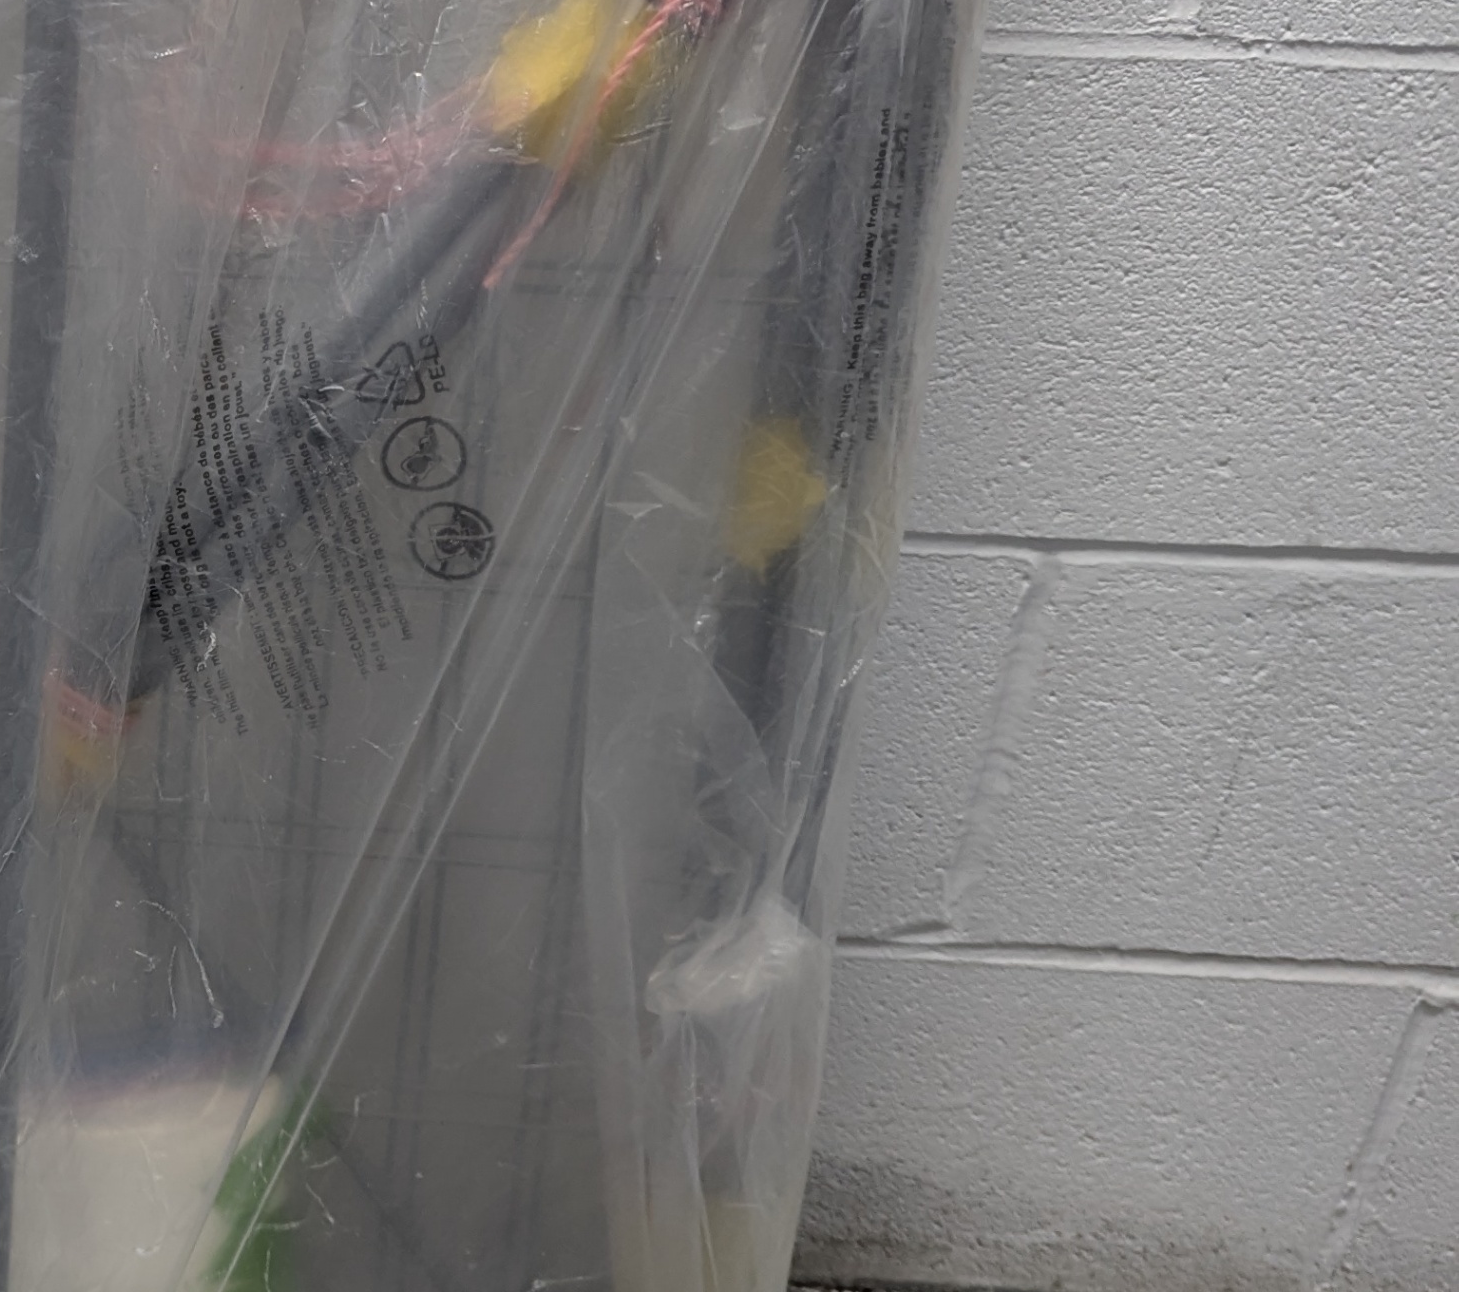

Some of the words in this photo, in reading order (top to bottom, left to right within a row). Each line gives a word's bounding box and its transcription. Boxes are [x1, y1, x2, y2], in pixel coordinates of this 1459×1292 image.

[879, 108, 891, 136] and
[871, 140, 888, 189] babies
[865, 193, 880, 228] from
[862, 232, 877, 268] away
[855, 273, 872, 299] bag
[852, 304, 866, 330] this
[208, 324, 227, 371] collant
[847, 334, 862, 370] Keep
[200, 353, 215, 391] parcs
[419, 335, 449, 393] PE-LD
[218, 374, 229, 391] se
[205, 394, 217, 419] des
[221, 394, 230, 411] en
[210, 422, 219, 440] ou
[239, 422, 251, 440] un
[293, 429, 303, 438] o
[197, 451, 208, 467] de
[202, 471, 223, 527] distance
[163, 499, 177, 535] mou
[180, 510, 189, 520] a
[181, 523, 196, 546] not
[232, 518, 245, 538] des
[168, 539, 185, 562] and
[224, 543, 238, 567] sac
[171, 602, 183, 616] in
[156, 609, 173, 642] Keep
[250, 622, 293, 709] AVERTISSEMENT
[235, 714, 248, 735] The
